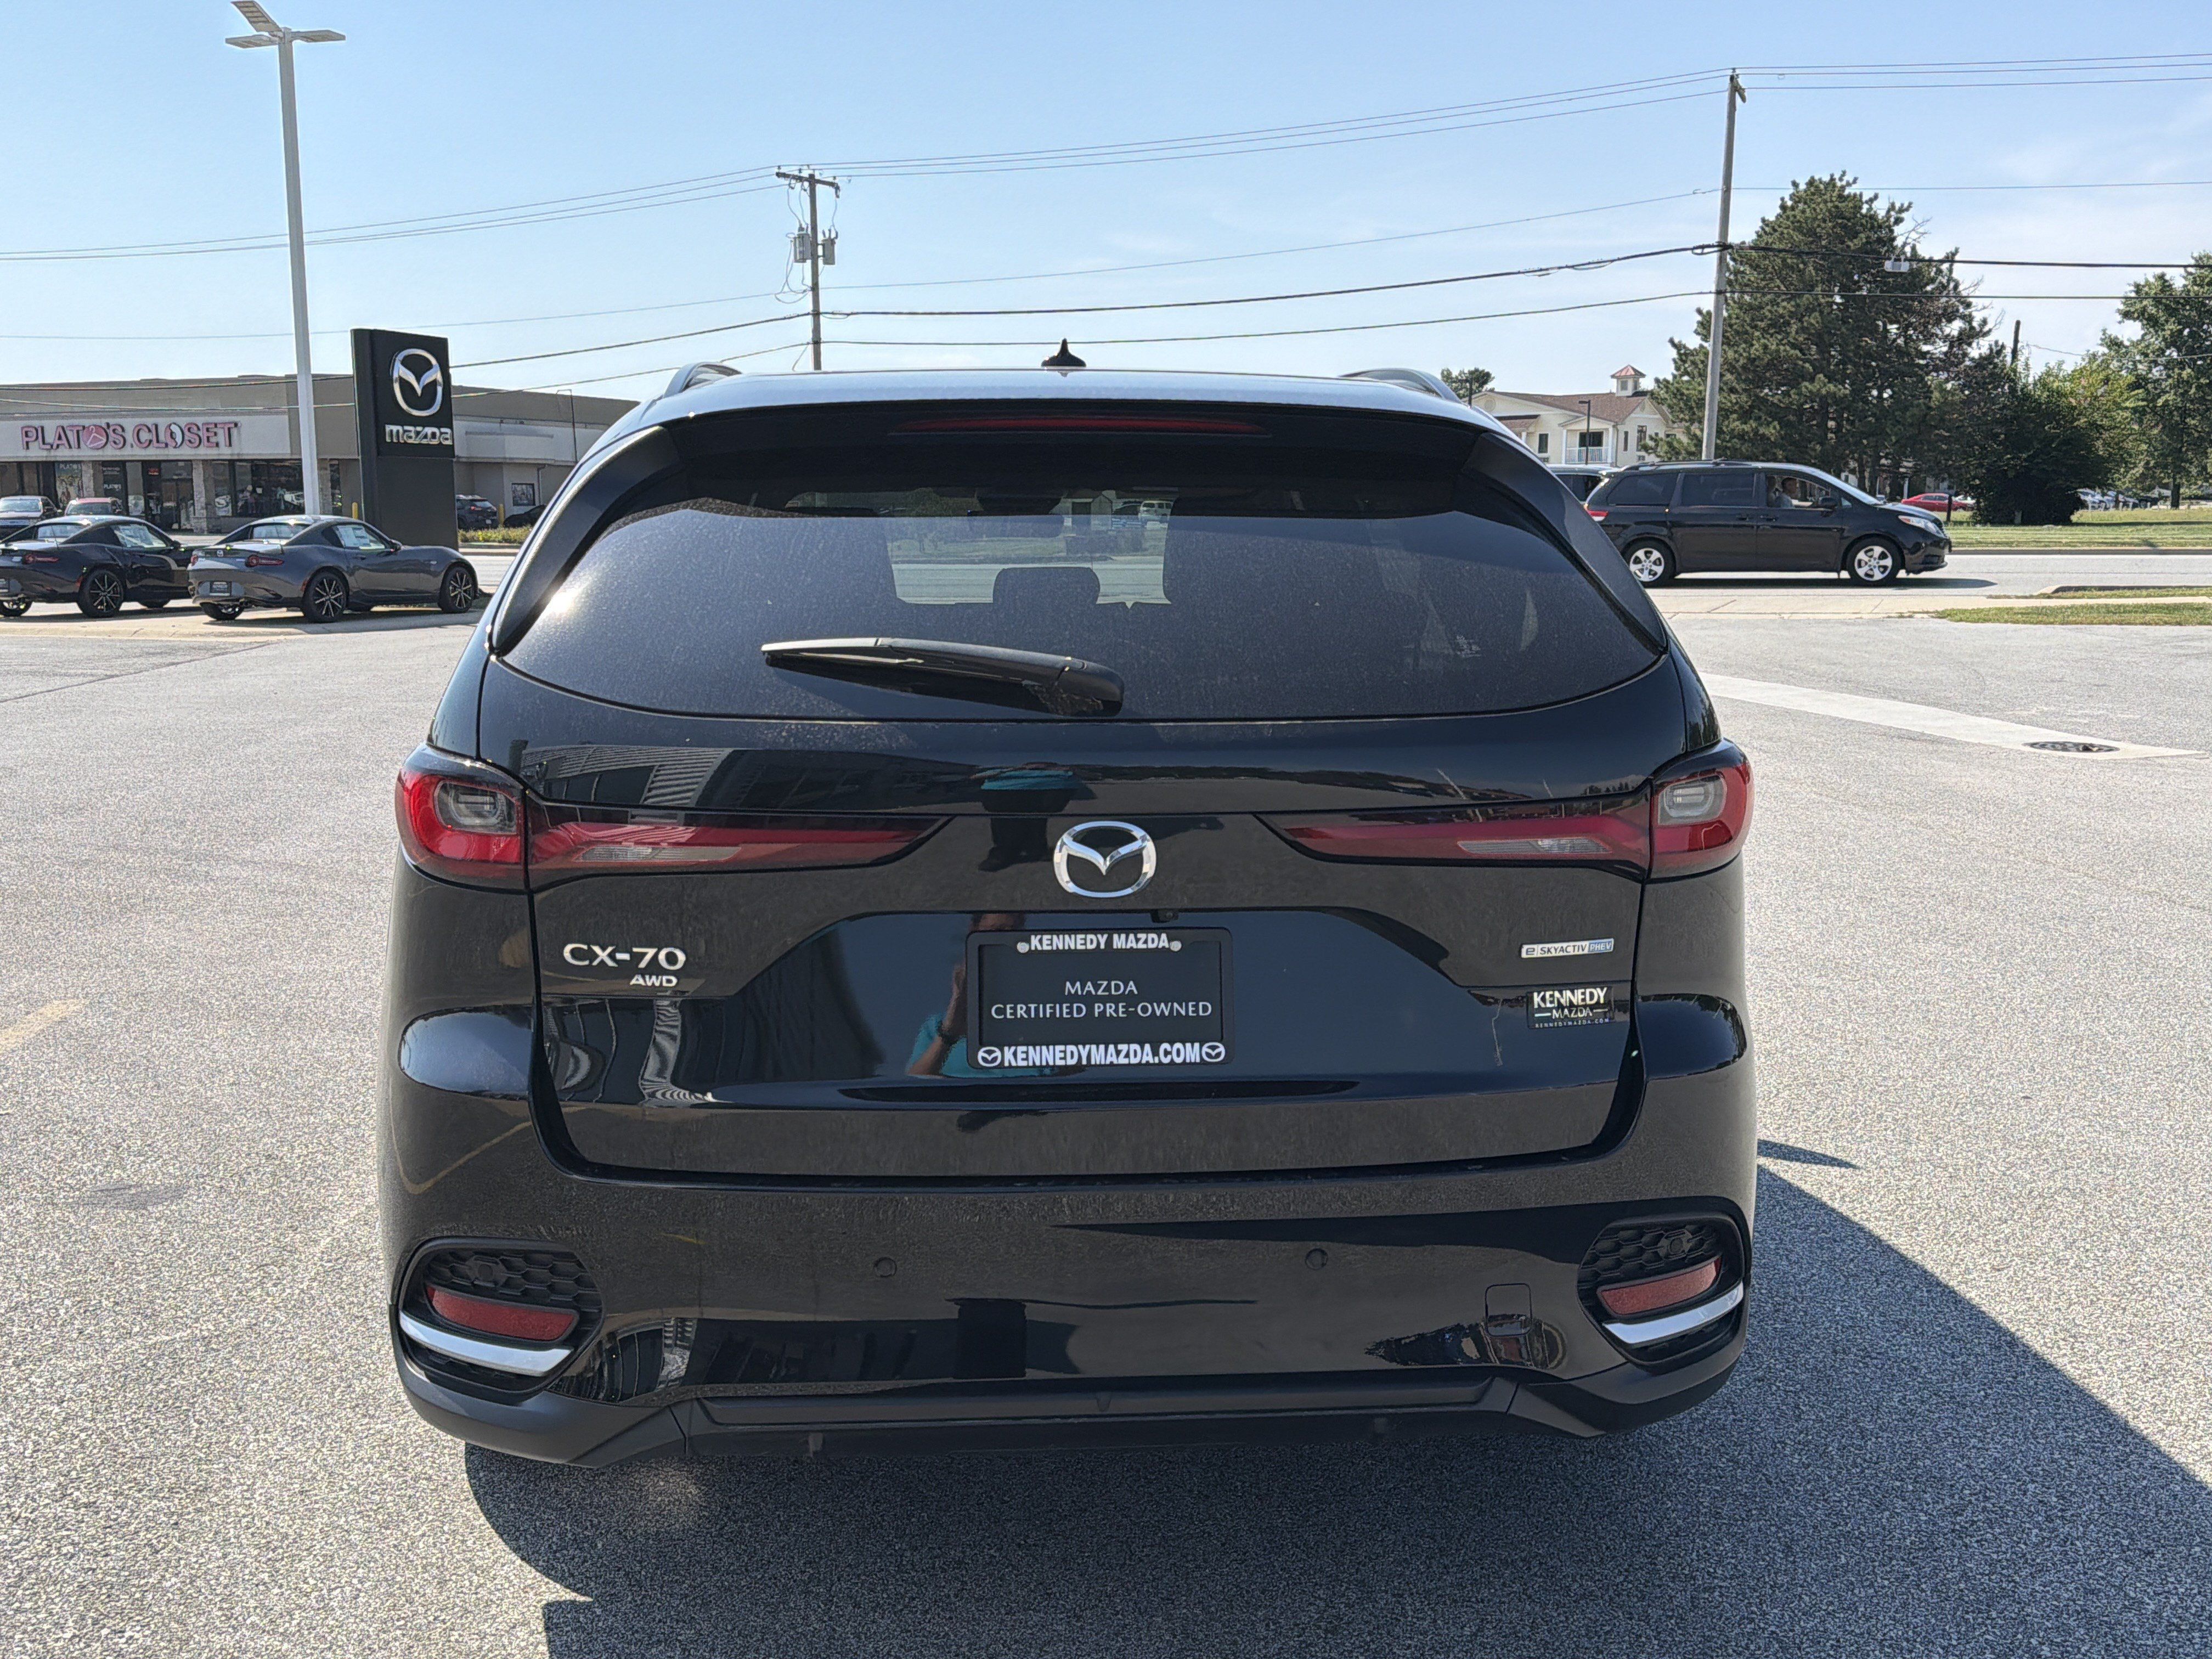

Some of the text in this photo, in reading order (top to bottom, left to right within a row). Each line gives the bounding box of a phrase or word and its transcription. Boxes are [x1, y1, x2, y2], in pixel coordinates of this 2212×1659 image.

[20, 422, 238, 450] PLATO'S CLOSET
[385, 424, 453, 445] mazda
[1030, 933, 1170, 951] KENNEDY MAZDA
[1539, 944, 1587, 955] SKYACTIV
[1589, 940, 1613, 951] PHEV
[563, 943, 686, 970] CX-70
[629, 974, 678, 987] AWD
[1065, 980, 1138, 996] MAZDA
[1533, 987, 1607, 1008] KENNEDY
[991, 1001, 1212, 1019] CERTIFIED PRE-OWNED
[1551, 1007, 1593, 1019] MAZDA
[1003, 1042, 1200, 1066] KENNEDYMAZDA.COM
